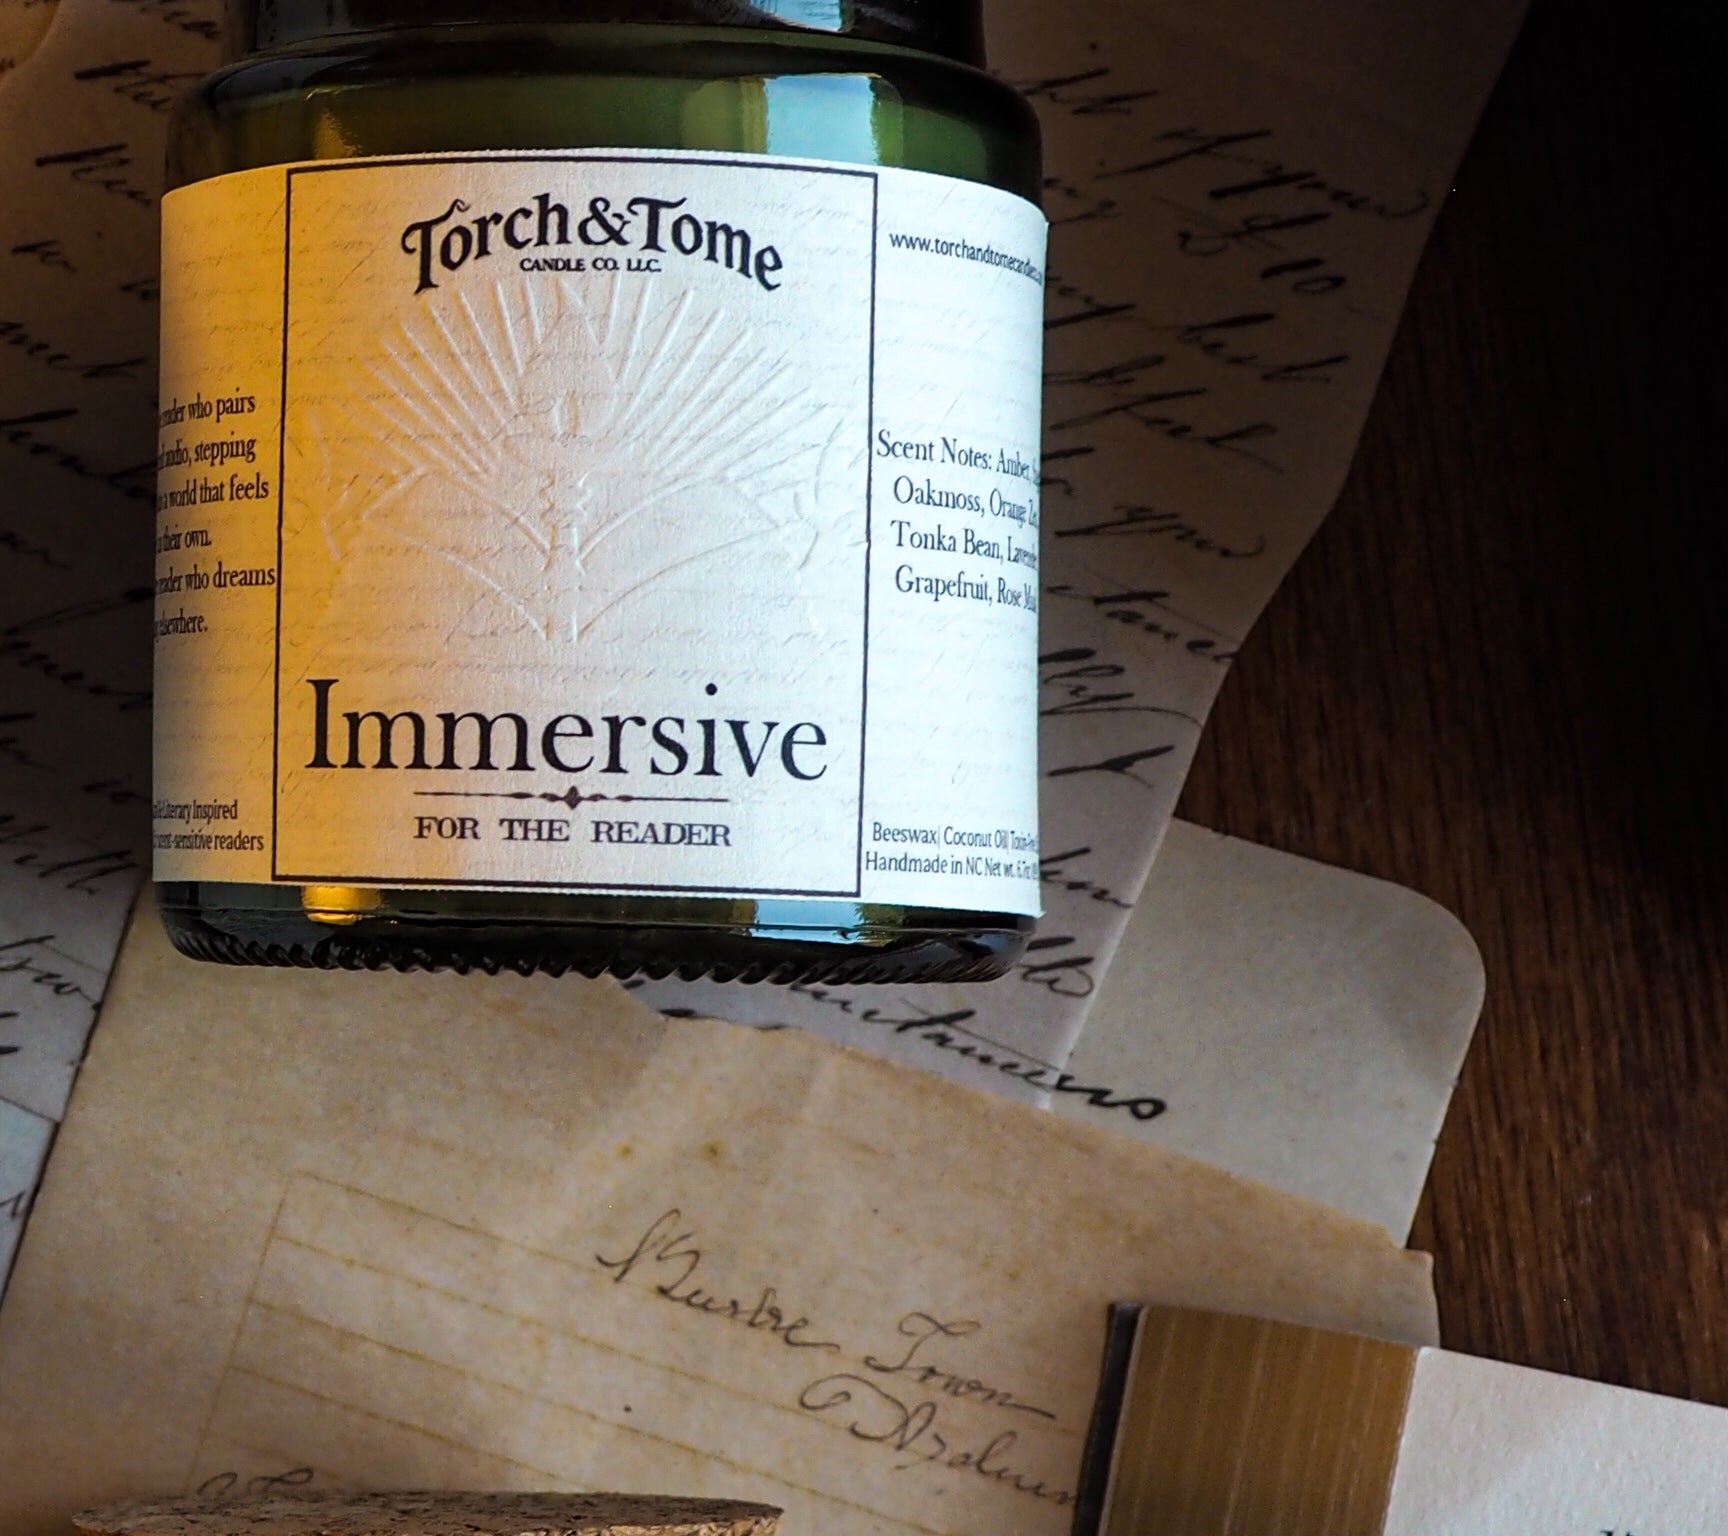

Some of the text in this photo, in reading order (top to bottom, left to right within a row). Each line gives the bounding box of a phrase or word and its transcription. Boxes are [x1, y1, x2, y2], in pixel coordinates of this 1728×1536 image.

[401, 192, 783, 295] Torch&Tome
[520, 257, 662, 272] CANDLE CO. LLC.
[216, 387, 256, 422] pairs
[194, 431, 257, 467] stepping
[876, 428, 992, 471] Scent Notes:
[200, 472, 269, 504] that feels
[893, 475, 985, 517] Oakmoss,
[890, 520, 1004, 565] Tonka Bean,
[212, 561, 275, 588] dreams
[893, 564, 1022, 607] Grapefruit, Rose
[304, 678, 827, 781] Immersive
[193, 798, 238, 825] Inspired
[214, 830, 264, 851] readers
[413, 816, 732, 847] FOR THE READER
[943, 826, 992, 847] Coconut
[865, 851, 983, 876] Handmade in NC
